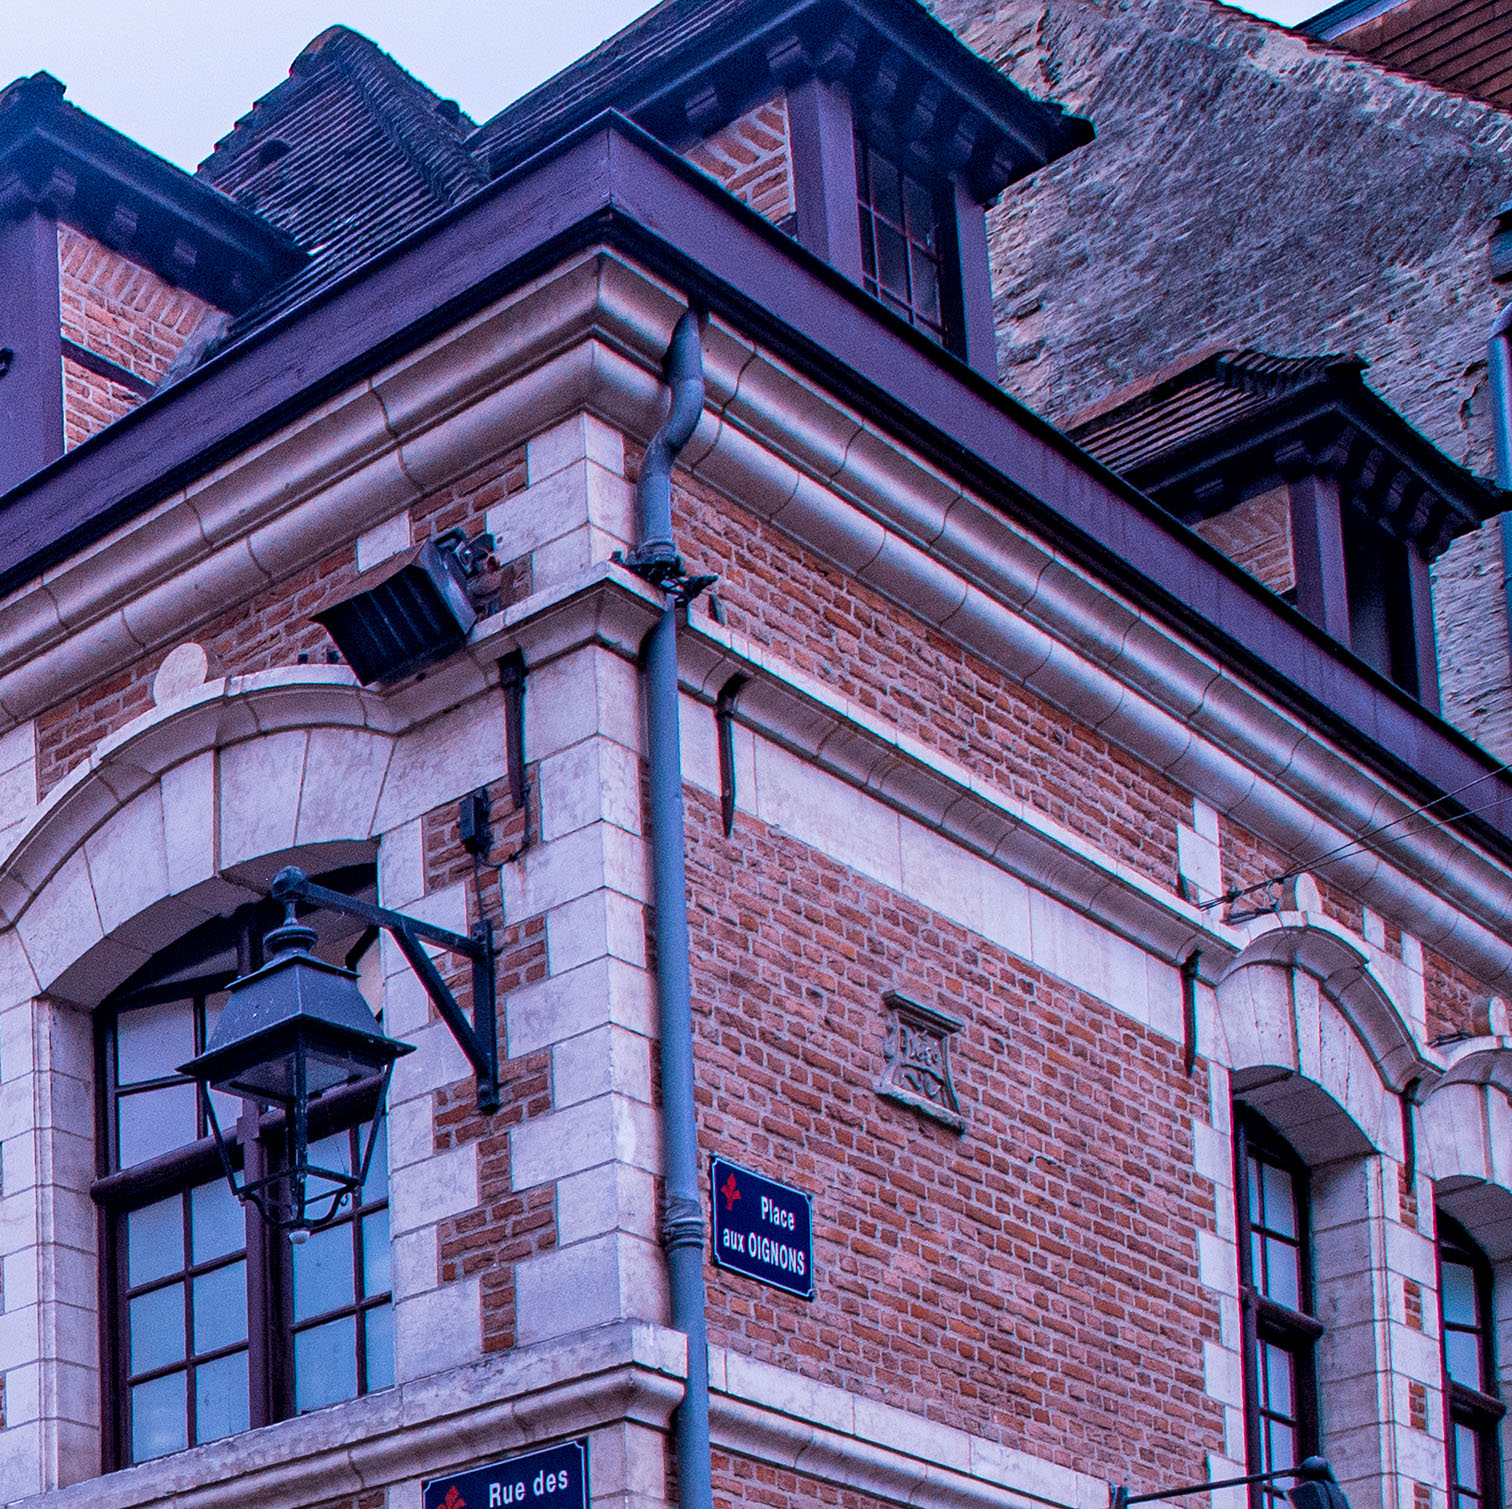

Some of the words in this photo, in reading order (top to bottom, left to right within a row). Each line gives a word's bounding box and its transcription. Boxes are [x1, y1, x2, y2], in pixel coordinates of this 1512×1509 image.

[761, 1195, 796, 1231] Place
[723, 1228, 745, 1253] aux
[748, 1231, 807, 1276] OIGNONS
[489, 1481, 526, 1508] Rue
[533, 1470, 568, 1496] des
